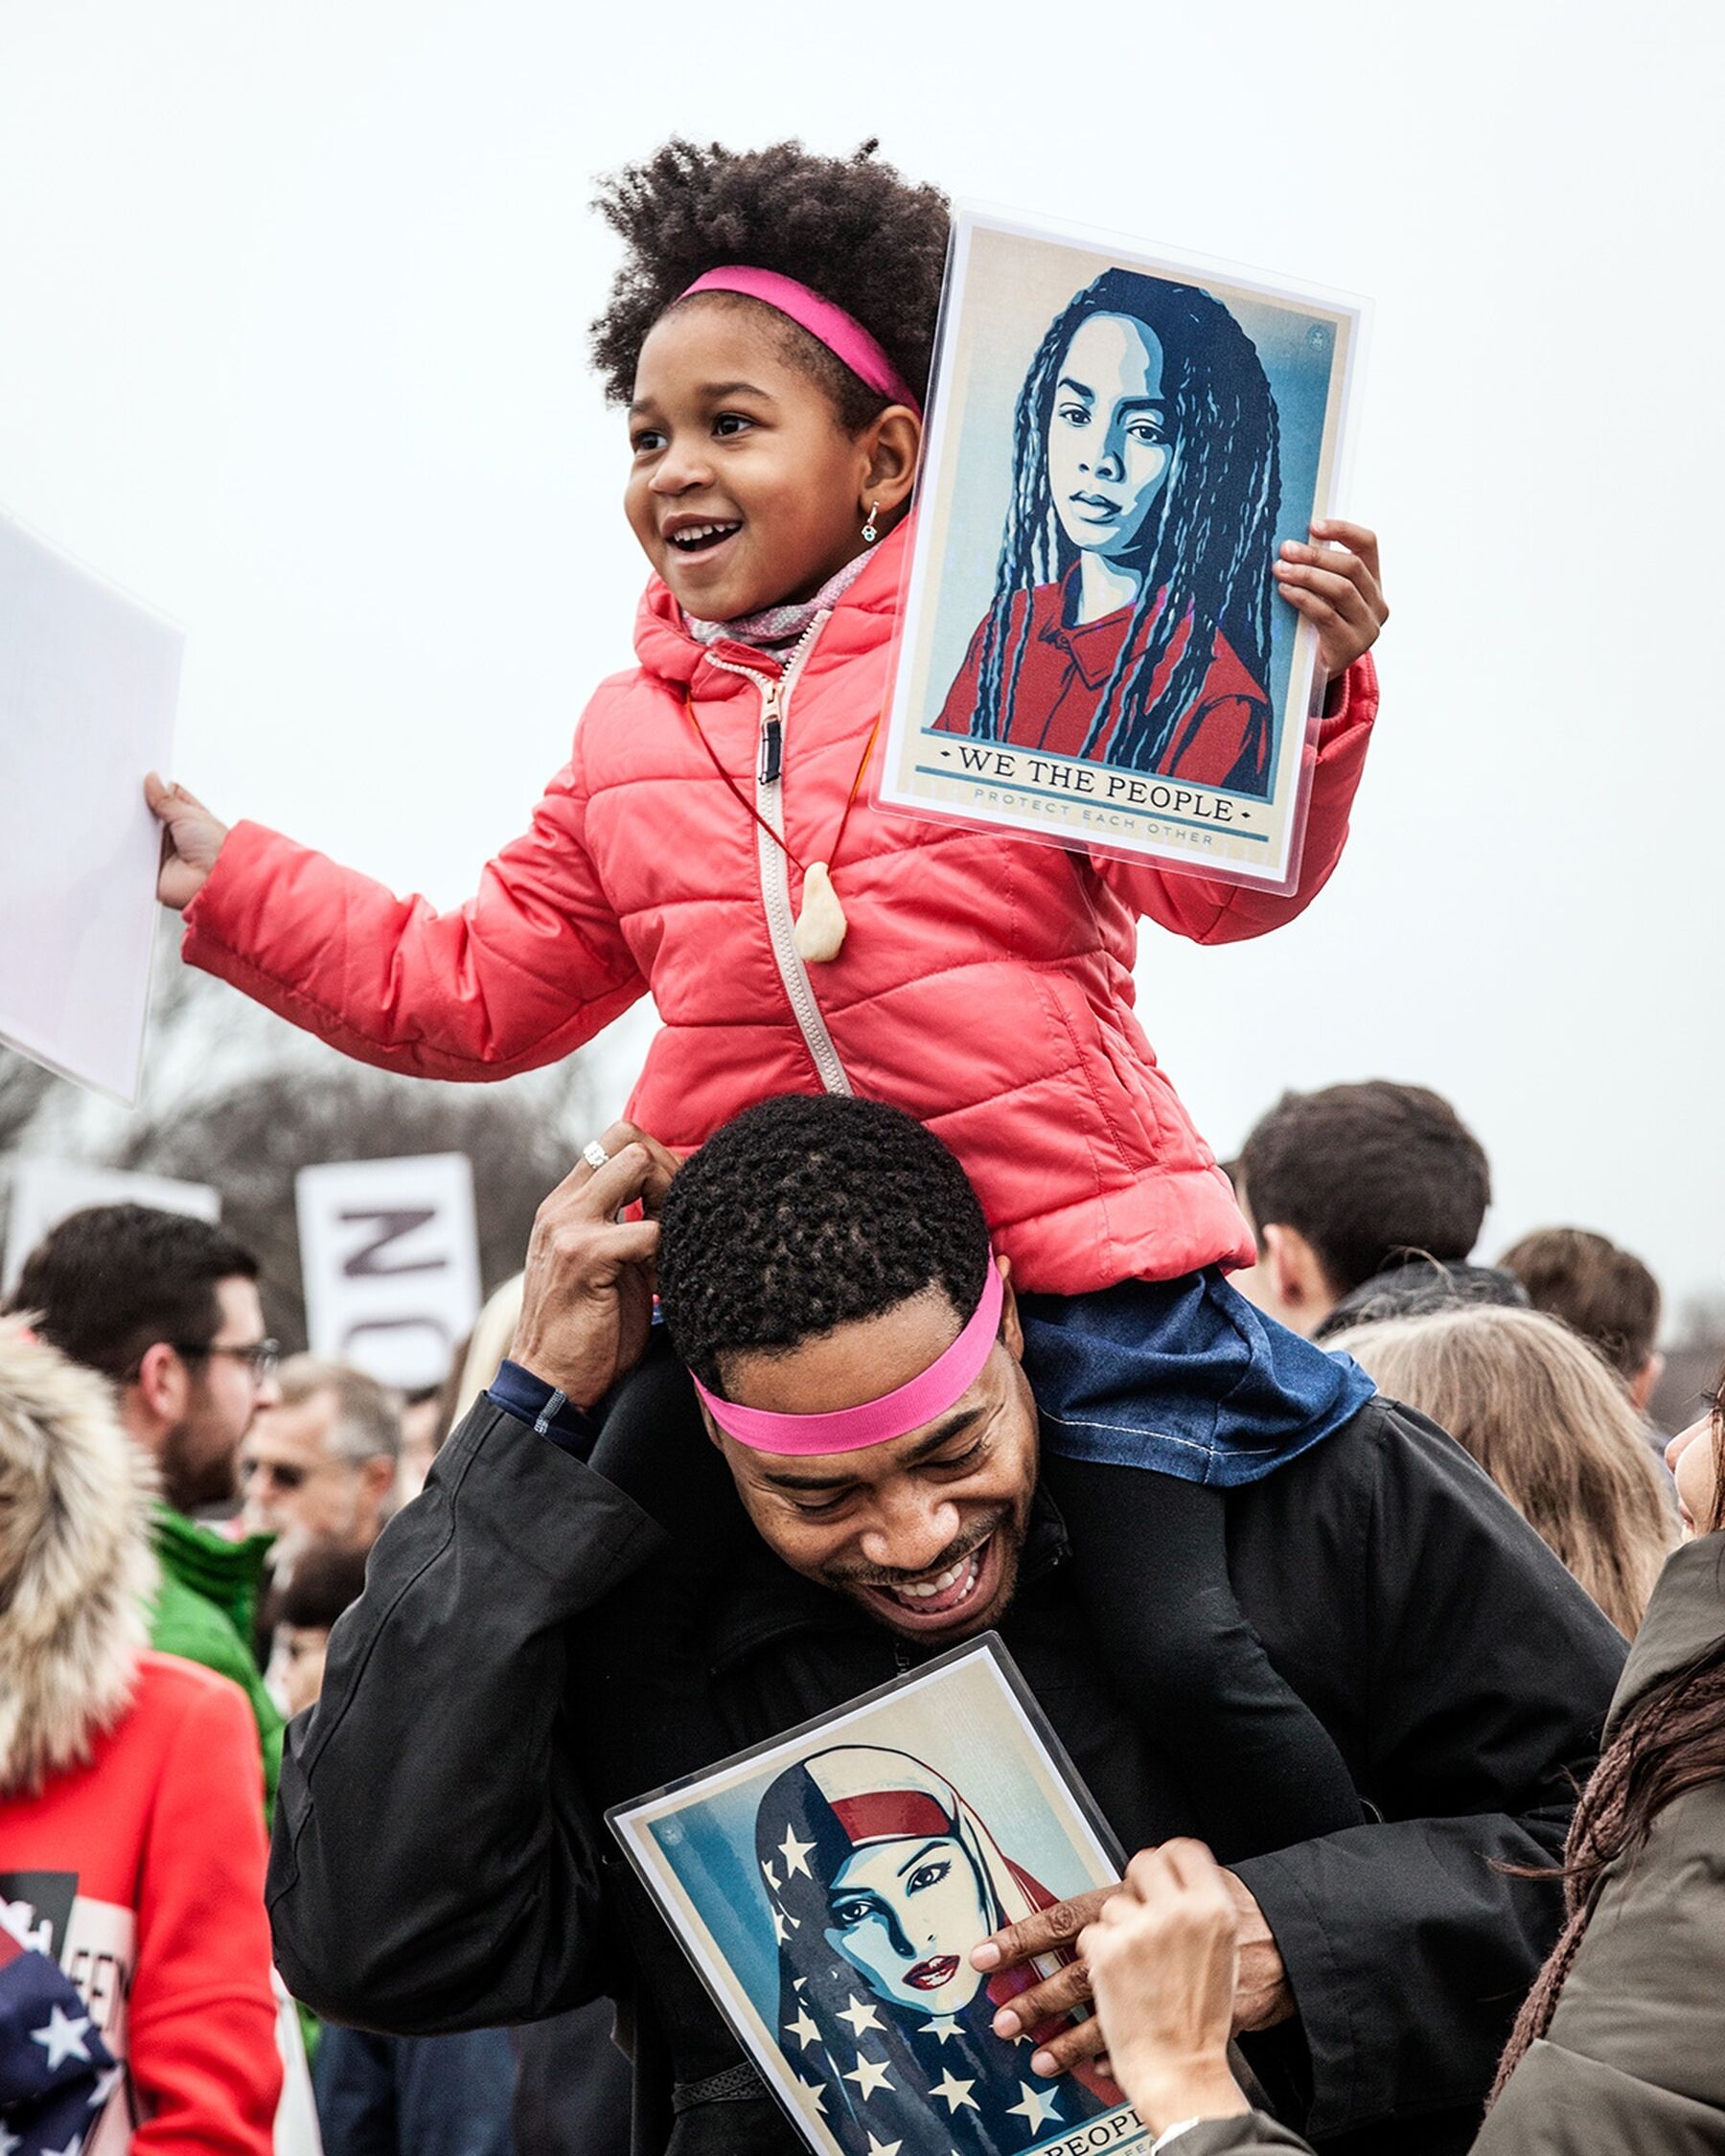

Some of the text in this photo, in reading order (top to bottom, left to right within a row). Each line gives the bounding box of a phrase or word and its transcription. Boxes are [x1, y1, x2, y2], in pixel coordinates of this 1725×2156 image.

[958, 745, 1234, 822] WE THE PEOPLE
[974, 789, 1214, 845] PROTECT EACH OTHER
[1044, 2108, 1145, 2156] PEOPL
